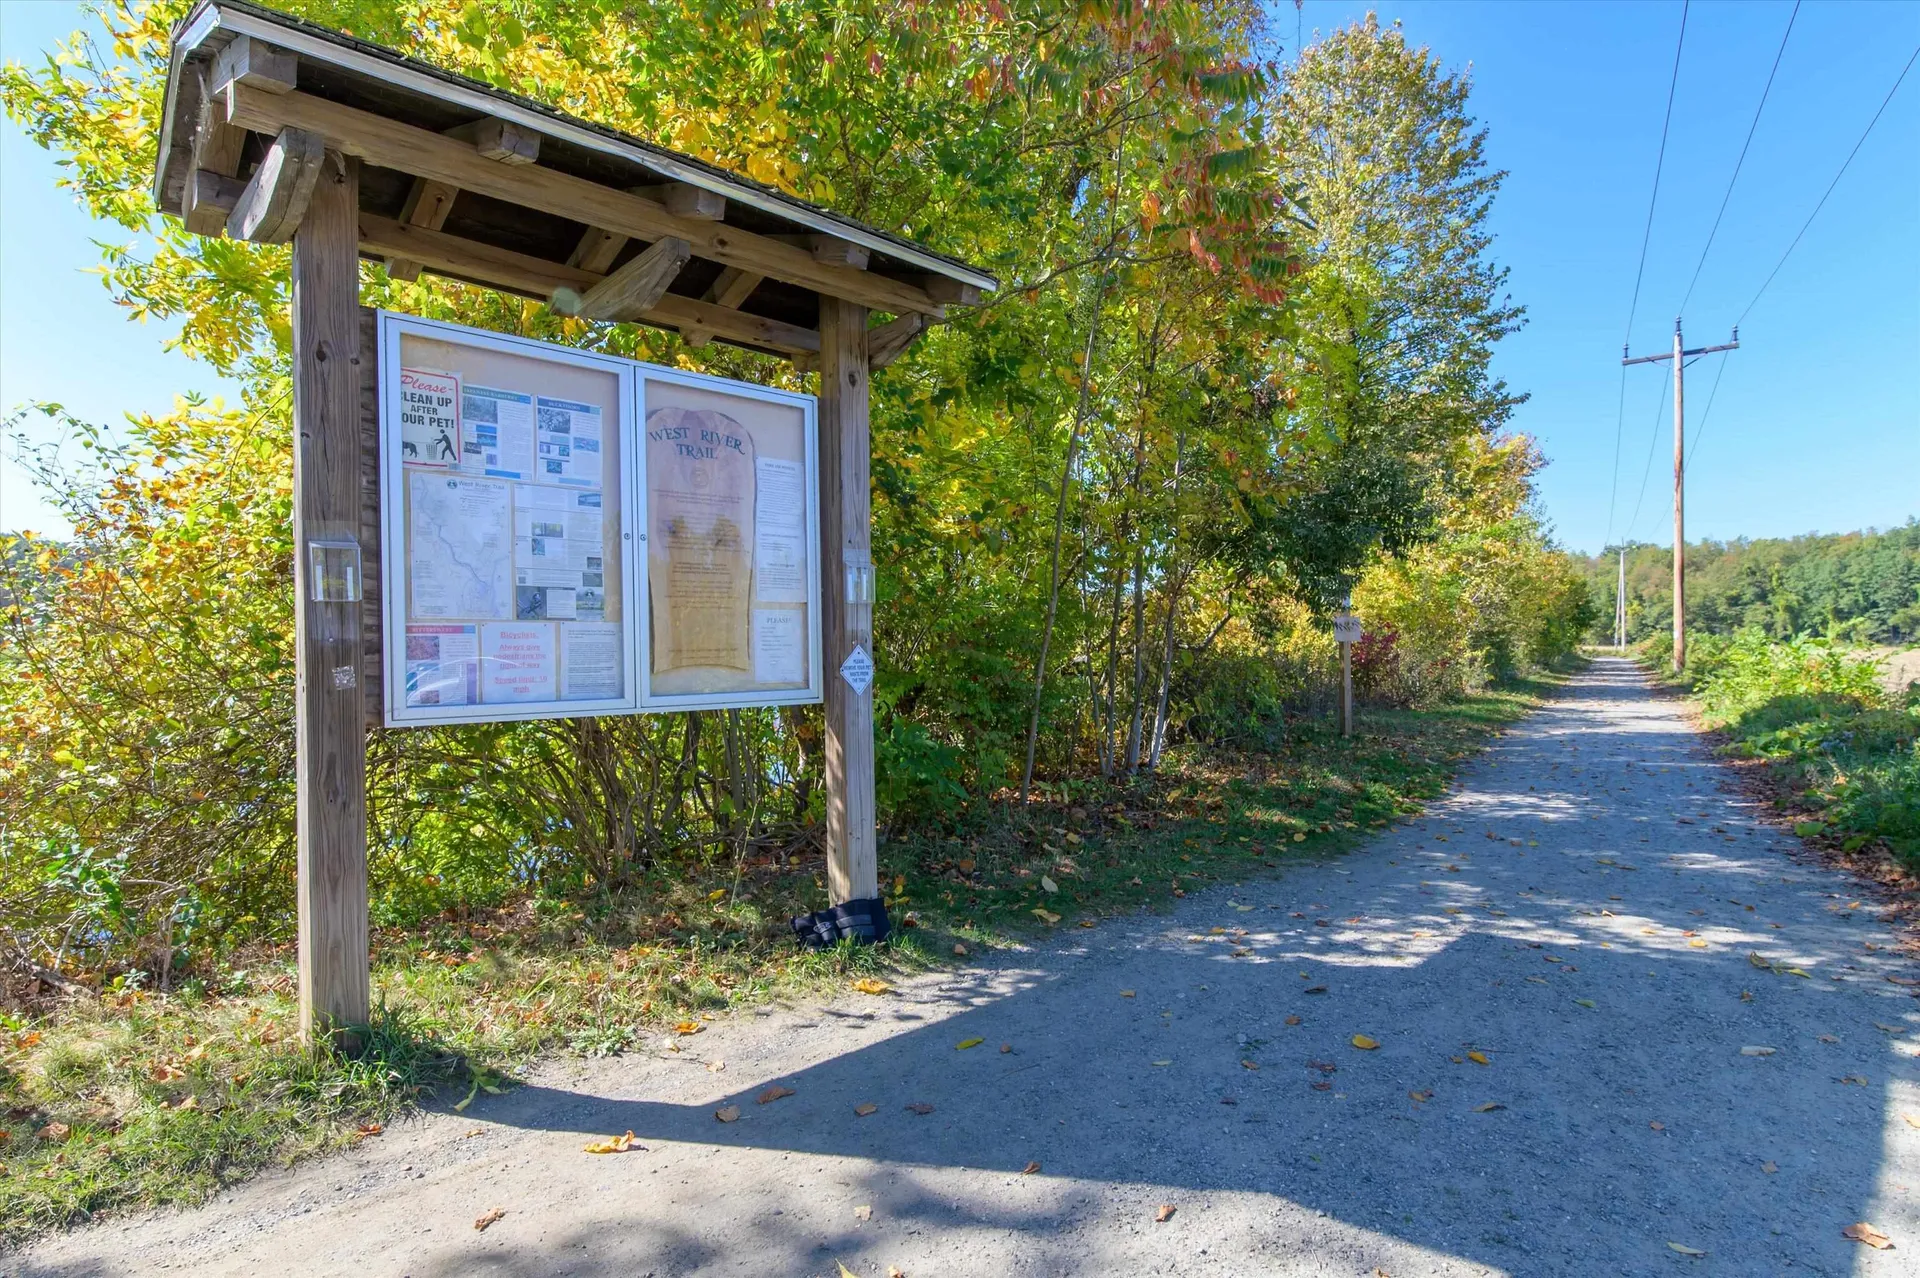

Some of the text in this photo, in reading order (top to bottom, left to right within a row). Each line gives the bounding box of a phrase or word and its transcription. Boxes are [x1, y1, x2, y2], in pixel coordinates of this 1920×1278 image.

[410, 404, 438, 415] AFTER
[437, 396, 452, 407] UP
[401, 412, 455, 428] OUR PET!
[649, 427, 746, 455] WEST RIVER
[676, 443, 718, 460] TRAIL
